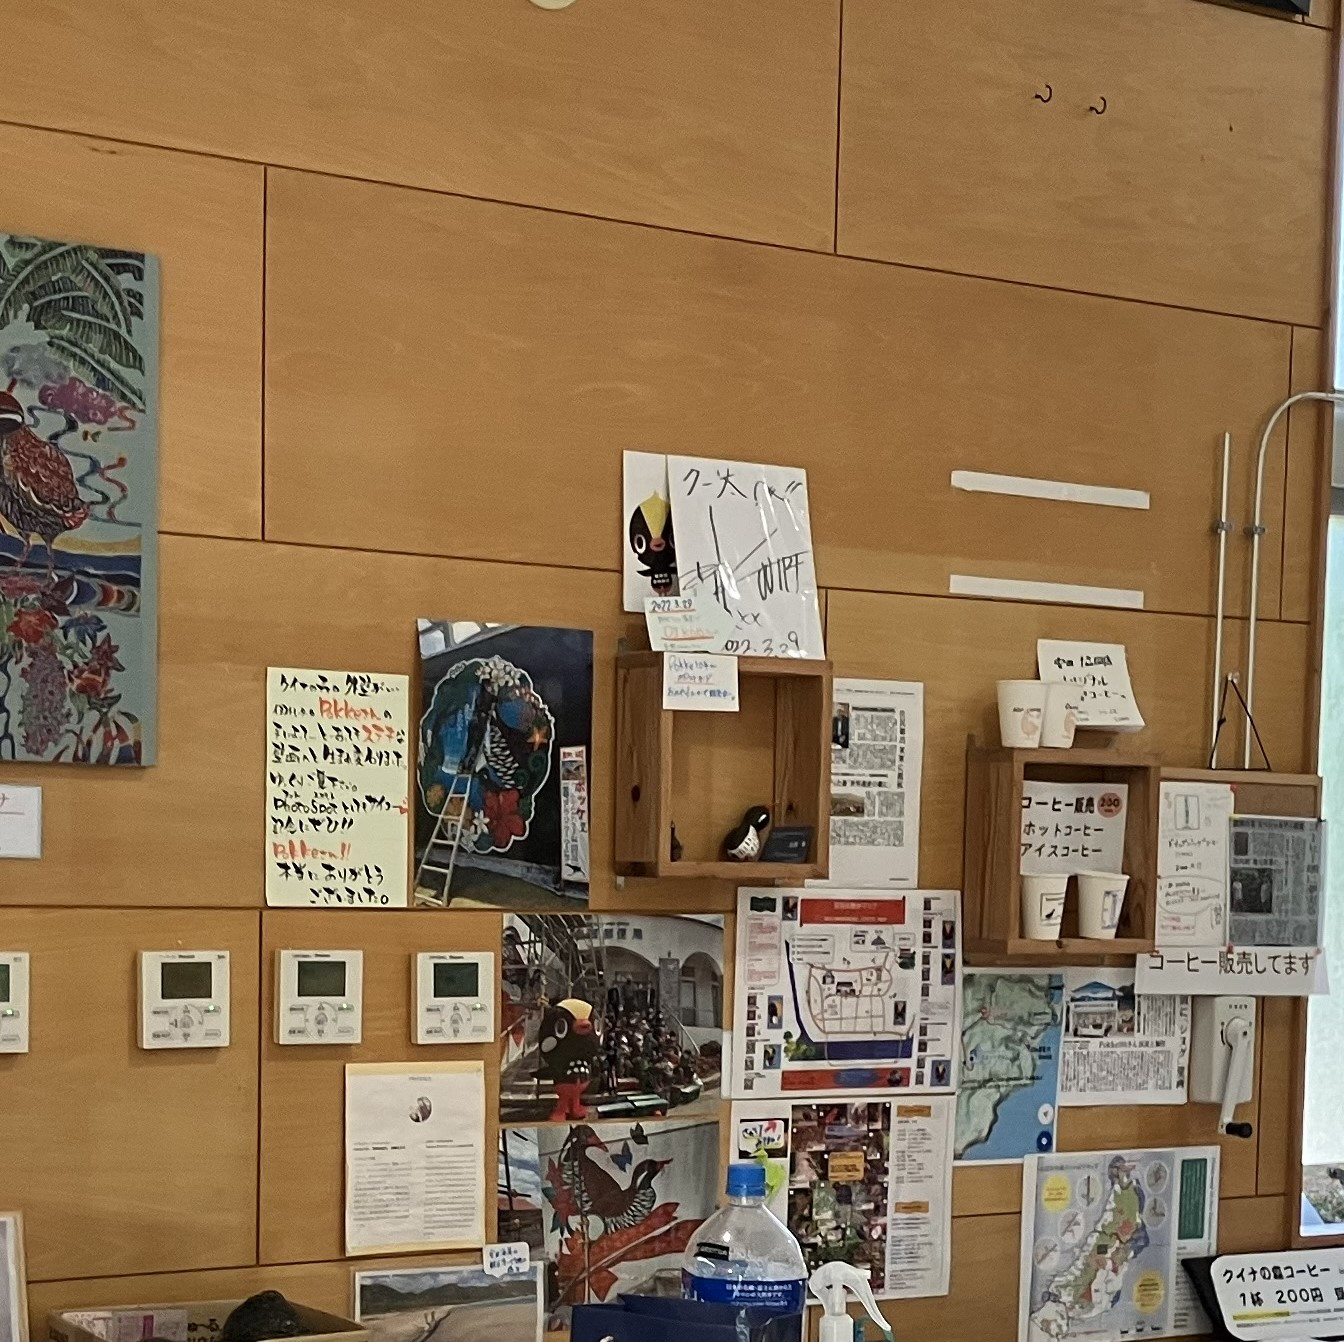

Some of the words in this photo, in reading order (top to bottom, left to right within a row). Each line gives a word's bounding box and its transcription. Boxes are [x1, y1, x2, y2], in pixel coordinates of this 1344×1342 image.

[1021, 796, 1095, 814] コーヒー販売
[1023, 820, 1104, 838] ホットコーヒー
[1021, 843, 1103, 858] アイスコーヒー
[1149, 950, 1314, 976] コーヒー販売してます
[1275, 1286, 1324, 1305] 200円
